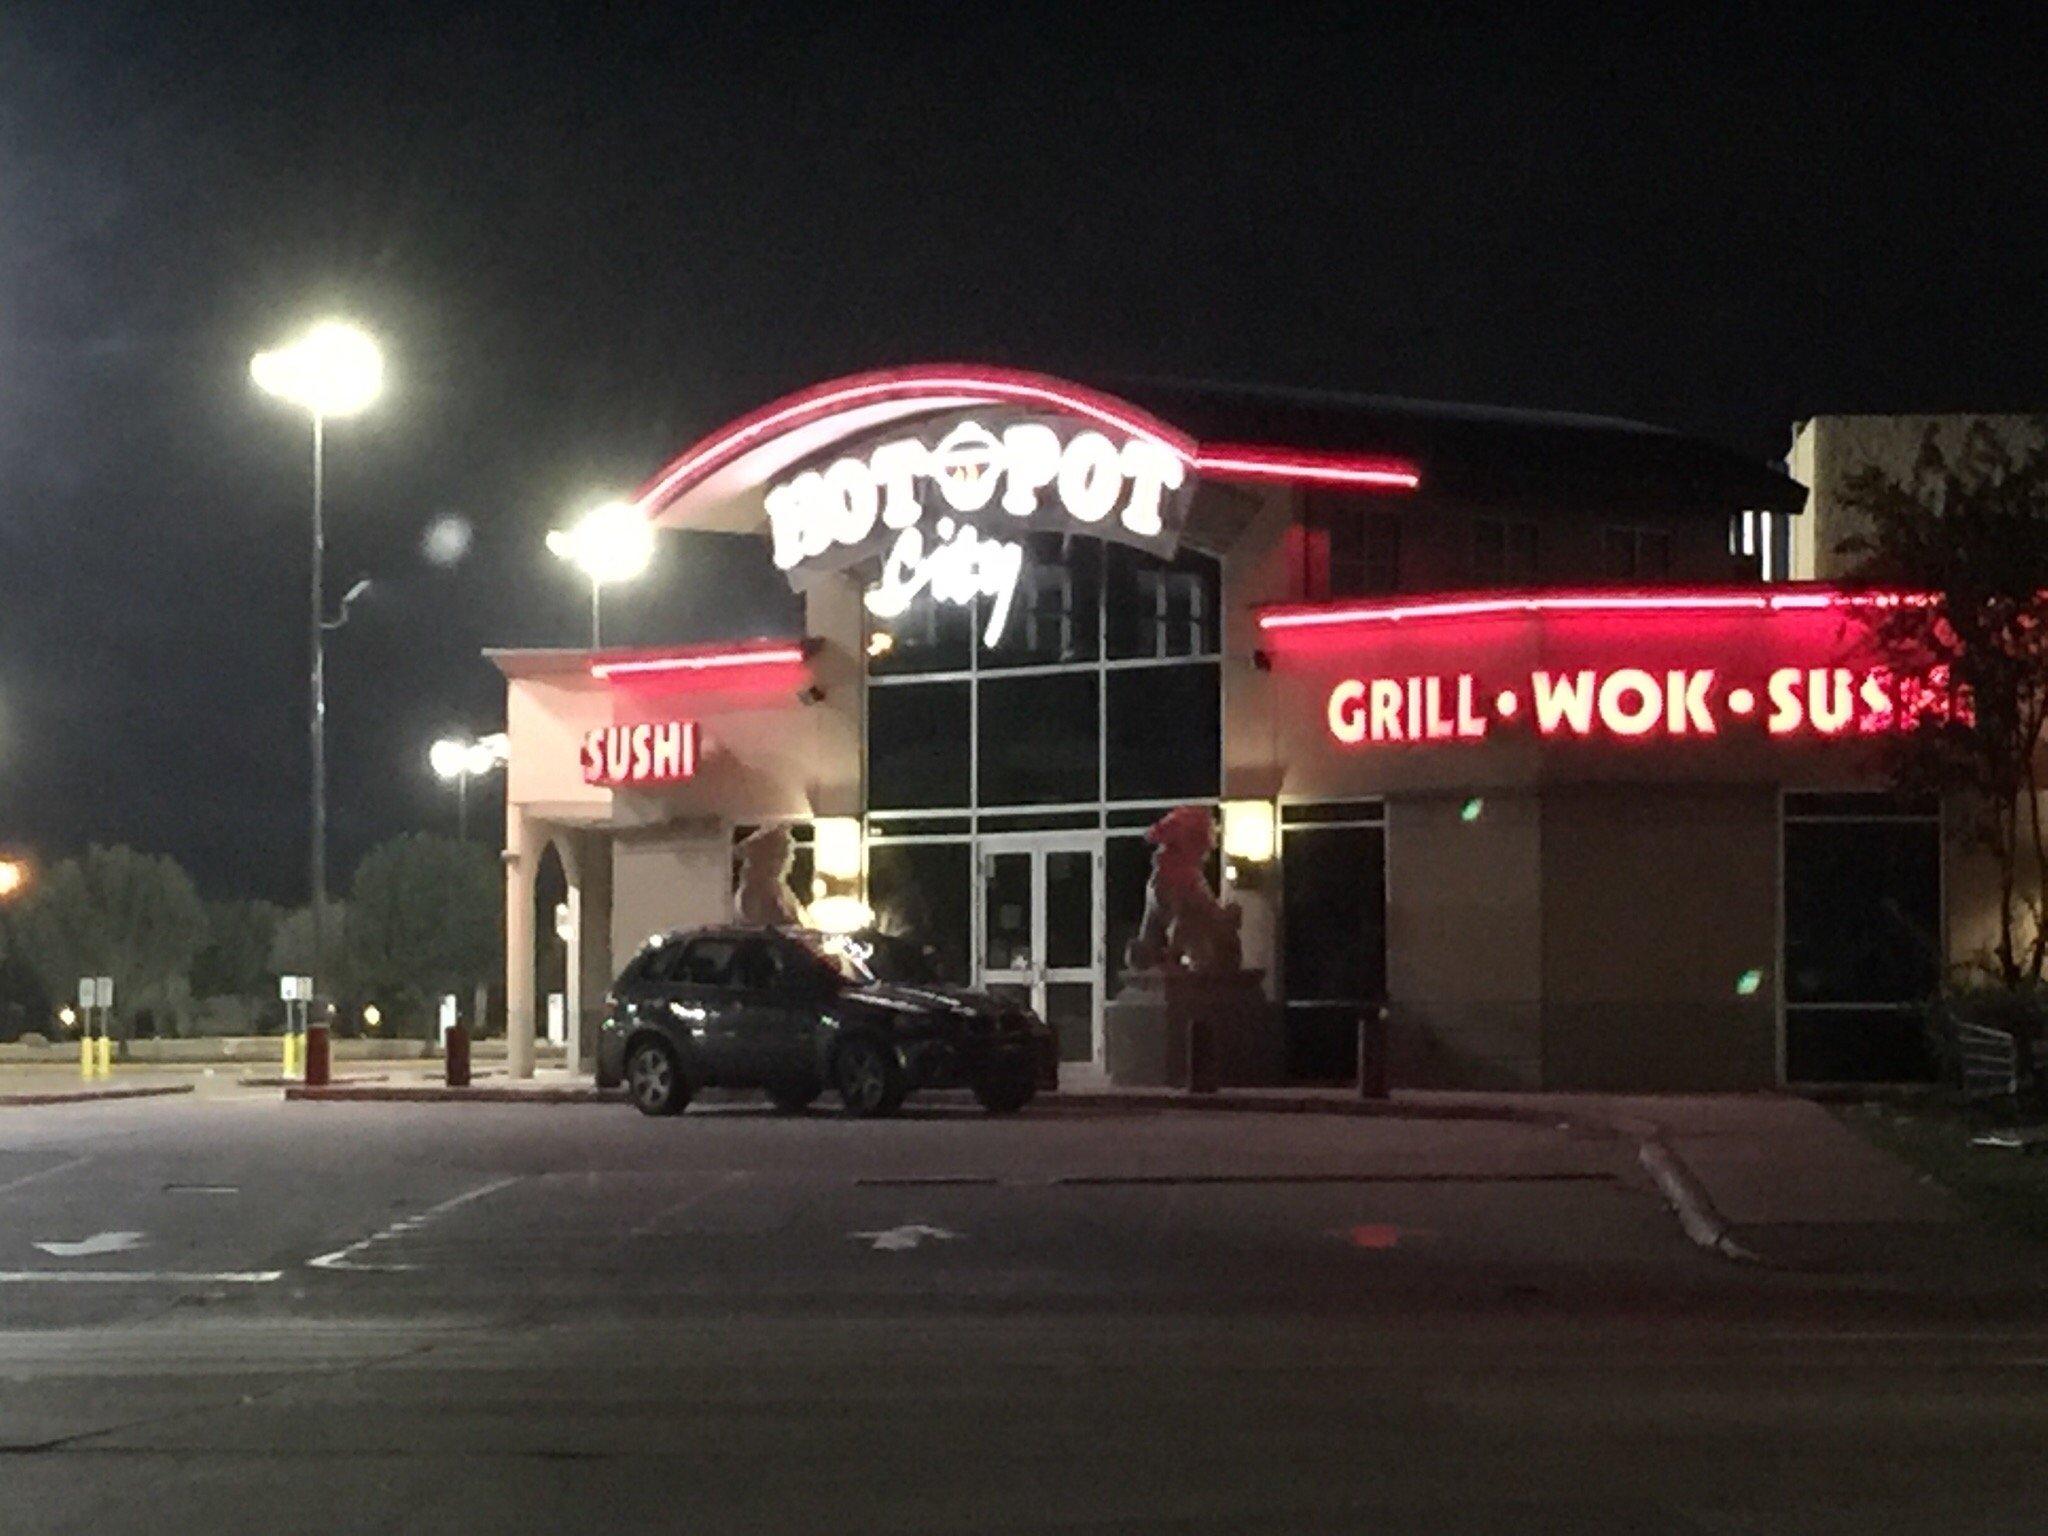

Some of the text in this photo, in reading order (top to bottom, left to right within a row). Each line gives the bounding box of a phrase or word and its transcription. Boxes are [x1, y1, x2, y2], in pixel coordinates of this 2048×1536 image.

[1001, 423, 1185, 536] POT
[1328, 674, 1487, 744] GRILL
[1531, 668, 1718, 736] WOK
[581, 721, 700, 784] SUSHI
